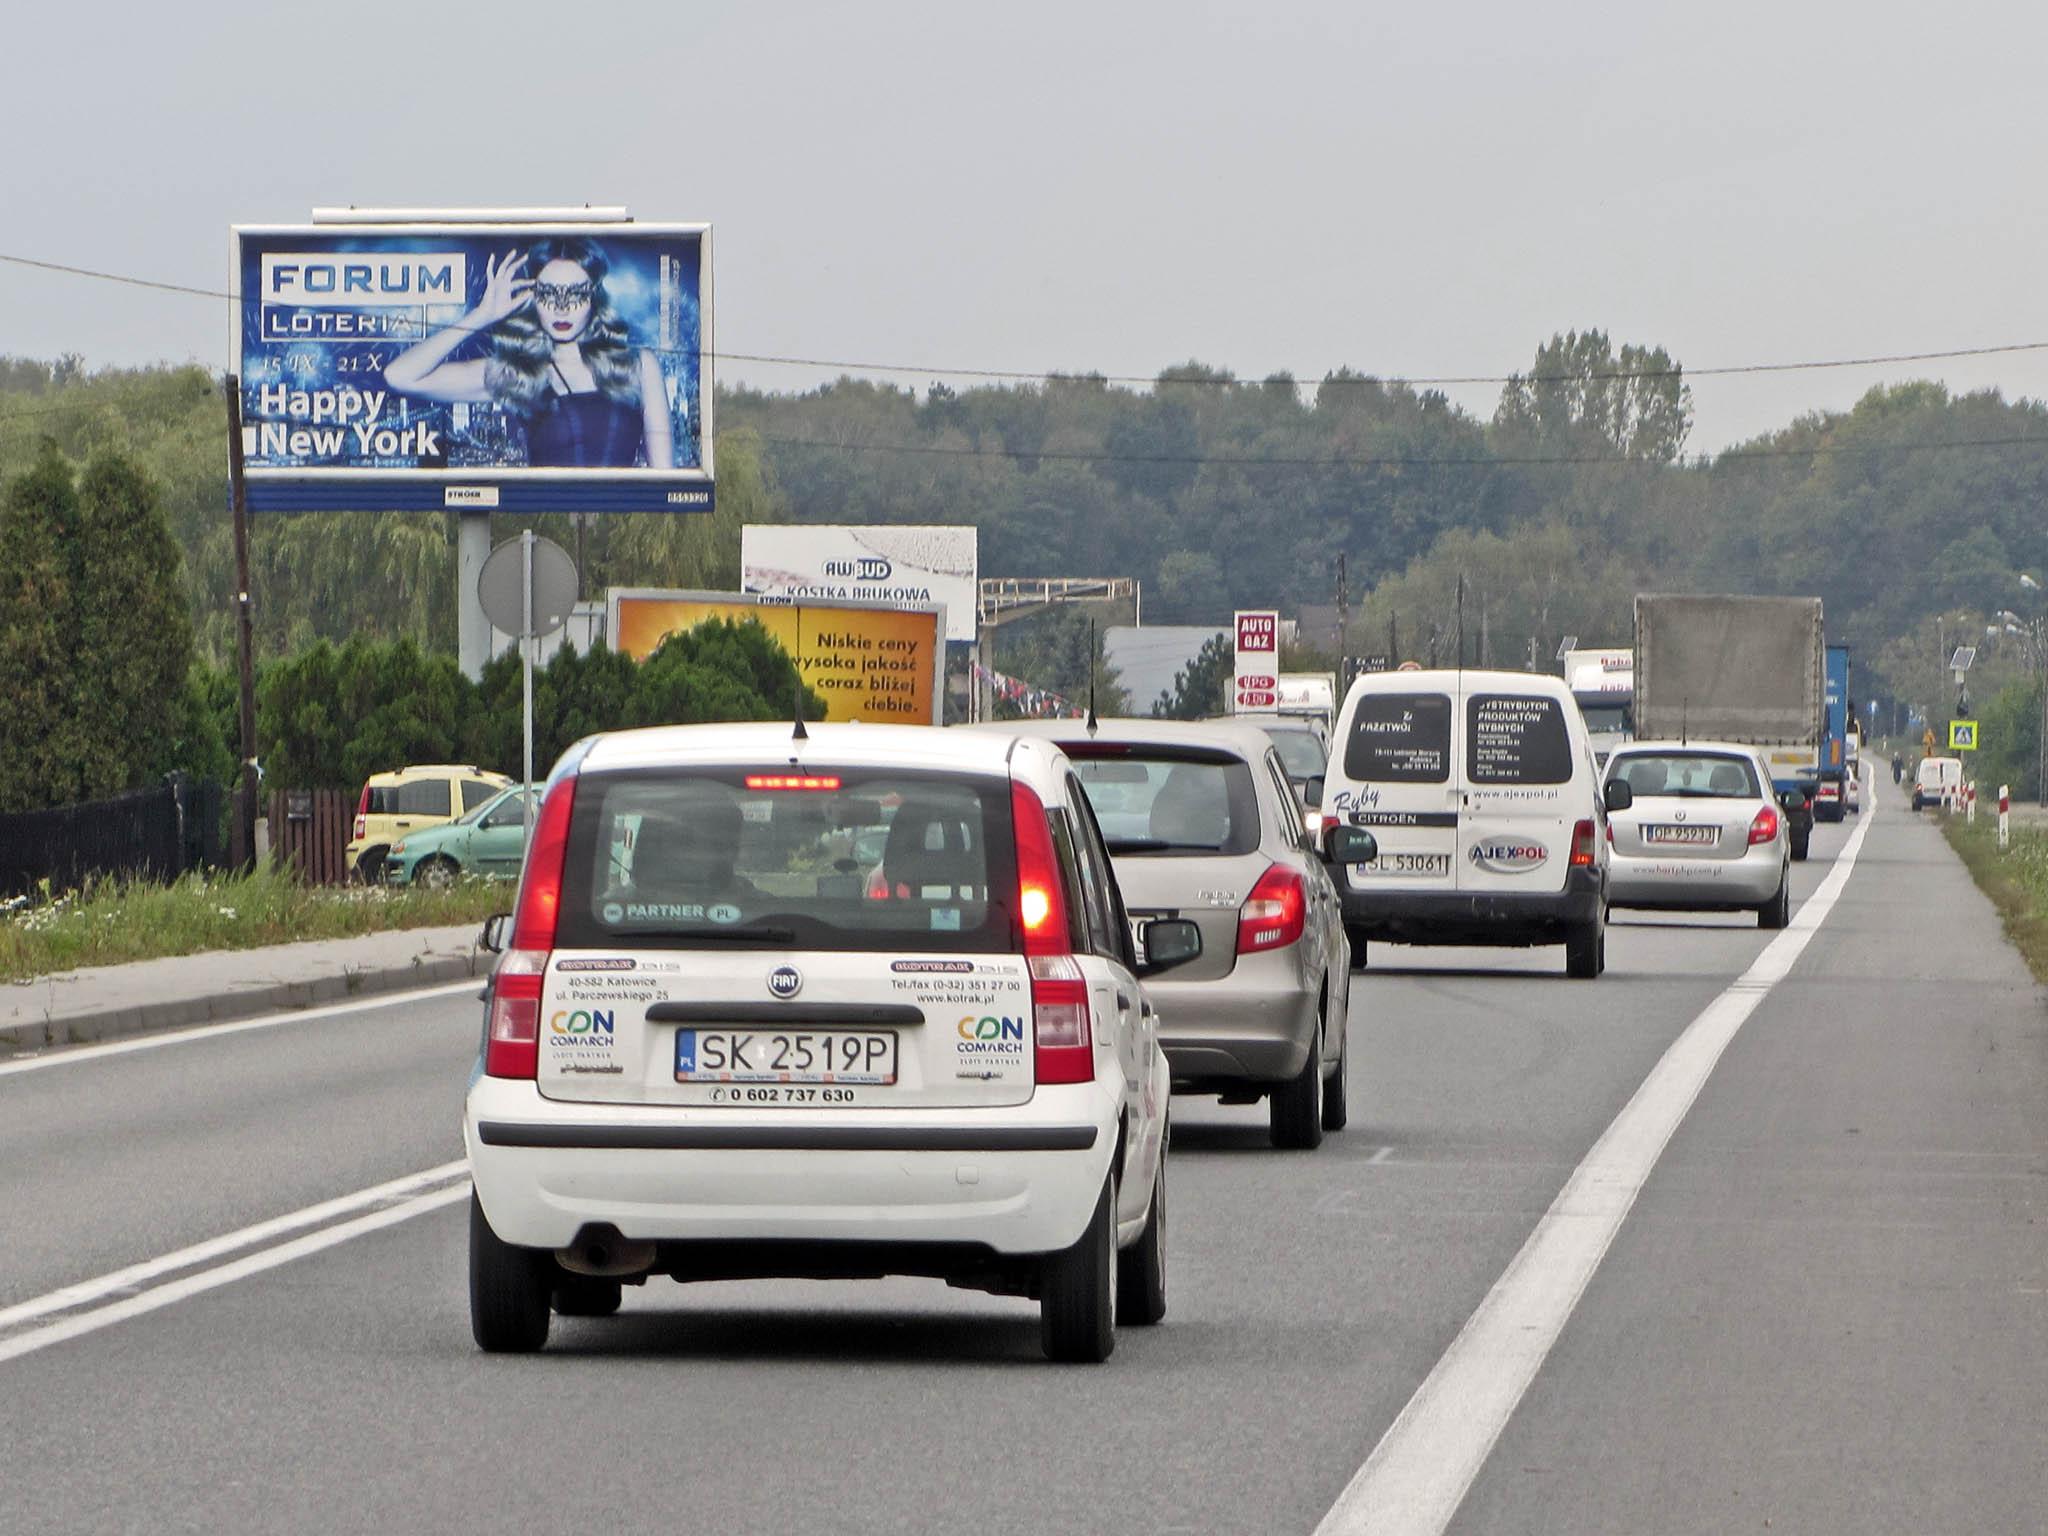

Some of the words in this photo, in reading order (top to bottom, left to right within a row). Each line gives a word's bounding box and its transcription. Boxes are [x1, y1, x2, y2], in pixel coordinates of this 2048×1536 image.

[272, 264, 451, 293] FORUM
[271, 313, 412, 333] LOTERIA
[336, 358, 359, 372] 21
[366, 352, 384, 372] X
[261, 383, 386, 424] Happy
[260, 422, 345, 456] New
[352, 420, 441, 456] York
[852, 586, 931, 601] BRUKOWA
[1240, 618, 1273, 633] AUTO
[817, 632, 872, 650] Niskie
[878, 639, 919, 654] ceny
[1243, 634, 1270, 649] GAZ
[862, 654, 918, 675] jakość
[817, 677, 864, 690] coraz
[869, 675, 915, 697] bliżej
[863, 696, 919, 713] ciebie.
[1477, 711, 1542, 723] PRODUKTÓW
[1473, 788, 1559, 800] www.ajexpol.pl
[1357, 813, 1418, 825] CITROËN
[1471, 846, 1548, 860] AJEXPOL
[1395, 855, 1443, 871] 53061
[627, 903, 705, 917] PARTNER
[606, 975, 657, 987] Katowice
[772, 973, 797, 988] FIAT
[968, 979, 986, 991] 351
[991, 980, 1004, 991] 27
[1007, 981, 1021, 992] 00
[571, 989, 653, 1002] Parczewskiego
[655, 989, 670, 1001] 25
[916, 993, 995, 1006] www.kotrak.pl
[550, 1035, 614, 1047] COMARCH
[956, 1042, 1023, 1053] COMARCH
[702, 1035, 753, 1070] SK
[770, 1036, 888, 1072] 2519P
[730, 1088, 741, 1101] 0
[746, 1088, 779, 1102] 602
[784, 1088, 817, 1102] 737
[822, 1088, 855, 1102] 630
